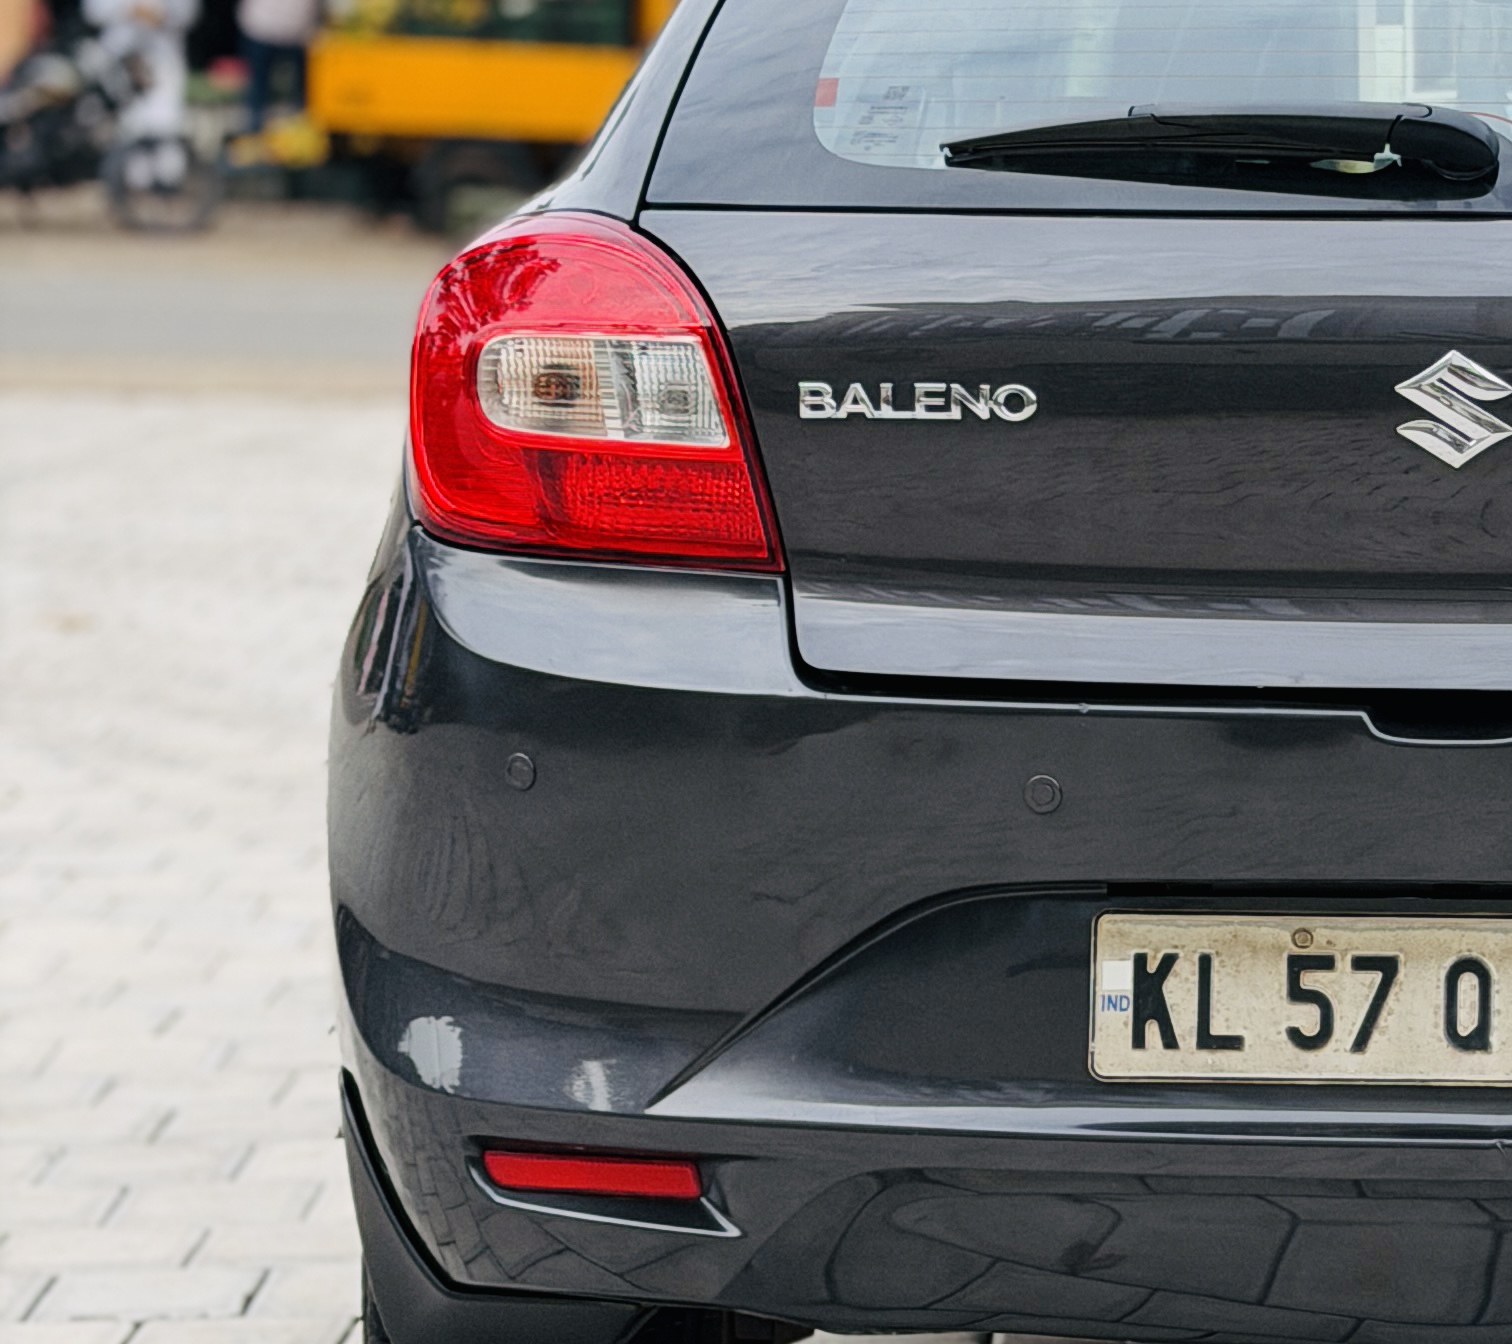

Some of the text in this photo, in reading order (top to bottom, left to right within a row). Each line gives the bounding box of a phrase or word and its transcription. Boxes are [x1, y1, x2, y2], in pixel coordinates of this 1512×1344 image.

[798, 381, 1037, 422] BALENO
[1100, 994, 1131, 1012] IND
[1131, 952, 1245, 1050] KL
[1285, 954, 1399, 1053] 57
[1444, 957, 1492, 1053] Q
